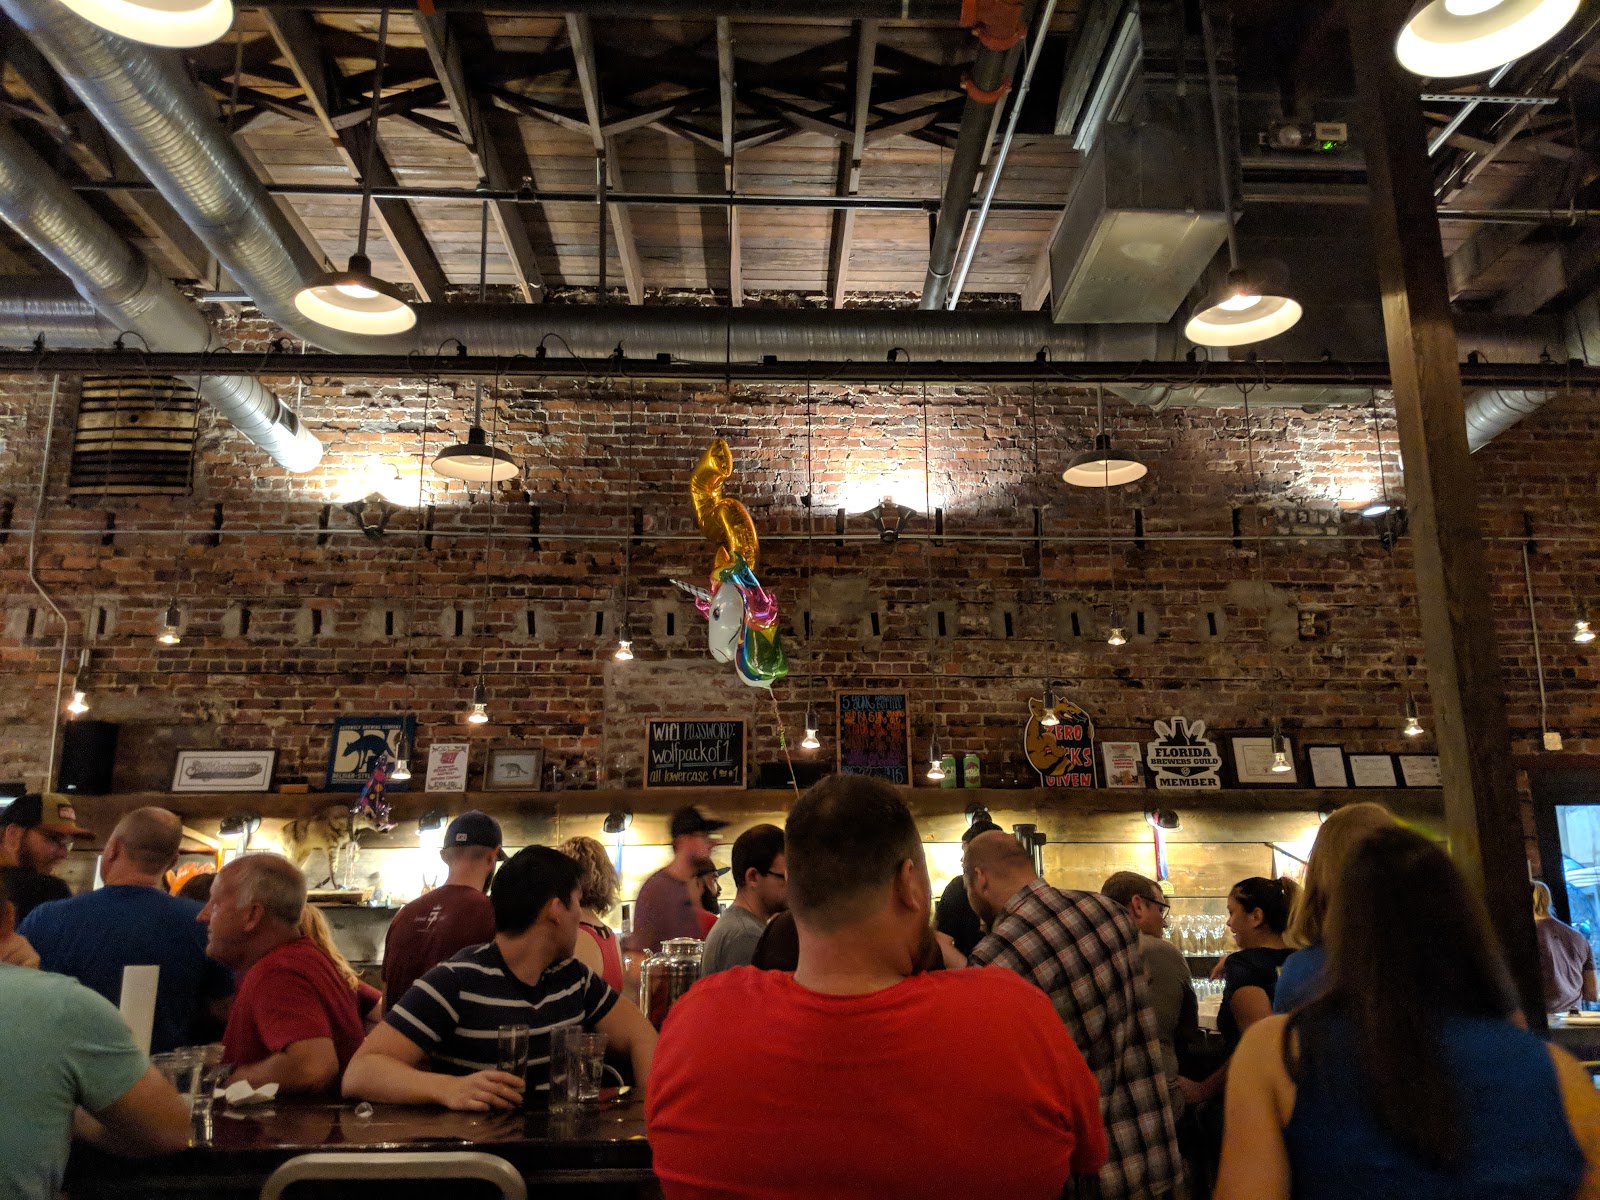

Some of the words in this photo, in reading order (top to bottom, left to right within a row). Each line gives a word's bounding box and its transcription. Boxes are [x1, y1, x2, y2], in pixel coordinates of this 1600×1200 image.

[1155, 747, 1212, 758] FLORIDA
[649, 769, 662, 782] all
[664, 769, 709, 782] lowercase
[1046, 773, 1092, 787] GIVEN
[1160, 778, 1218, 787] MEMBER
